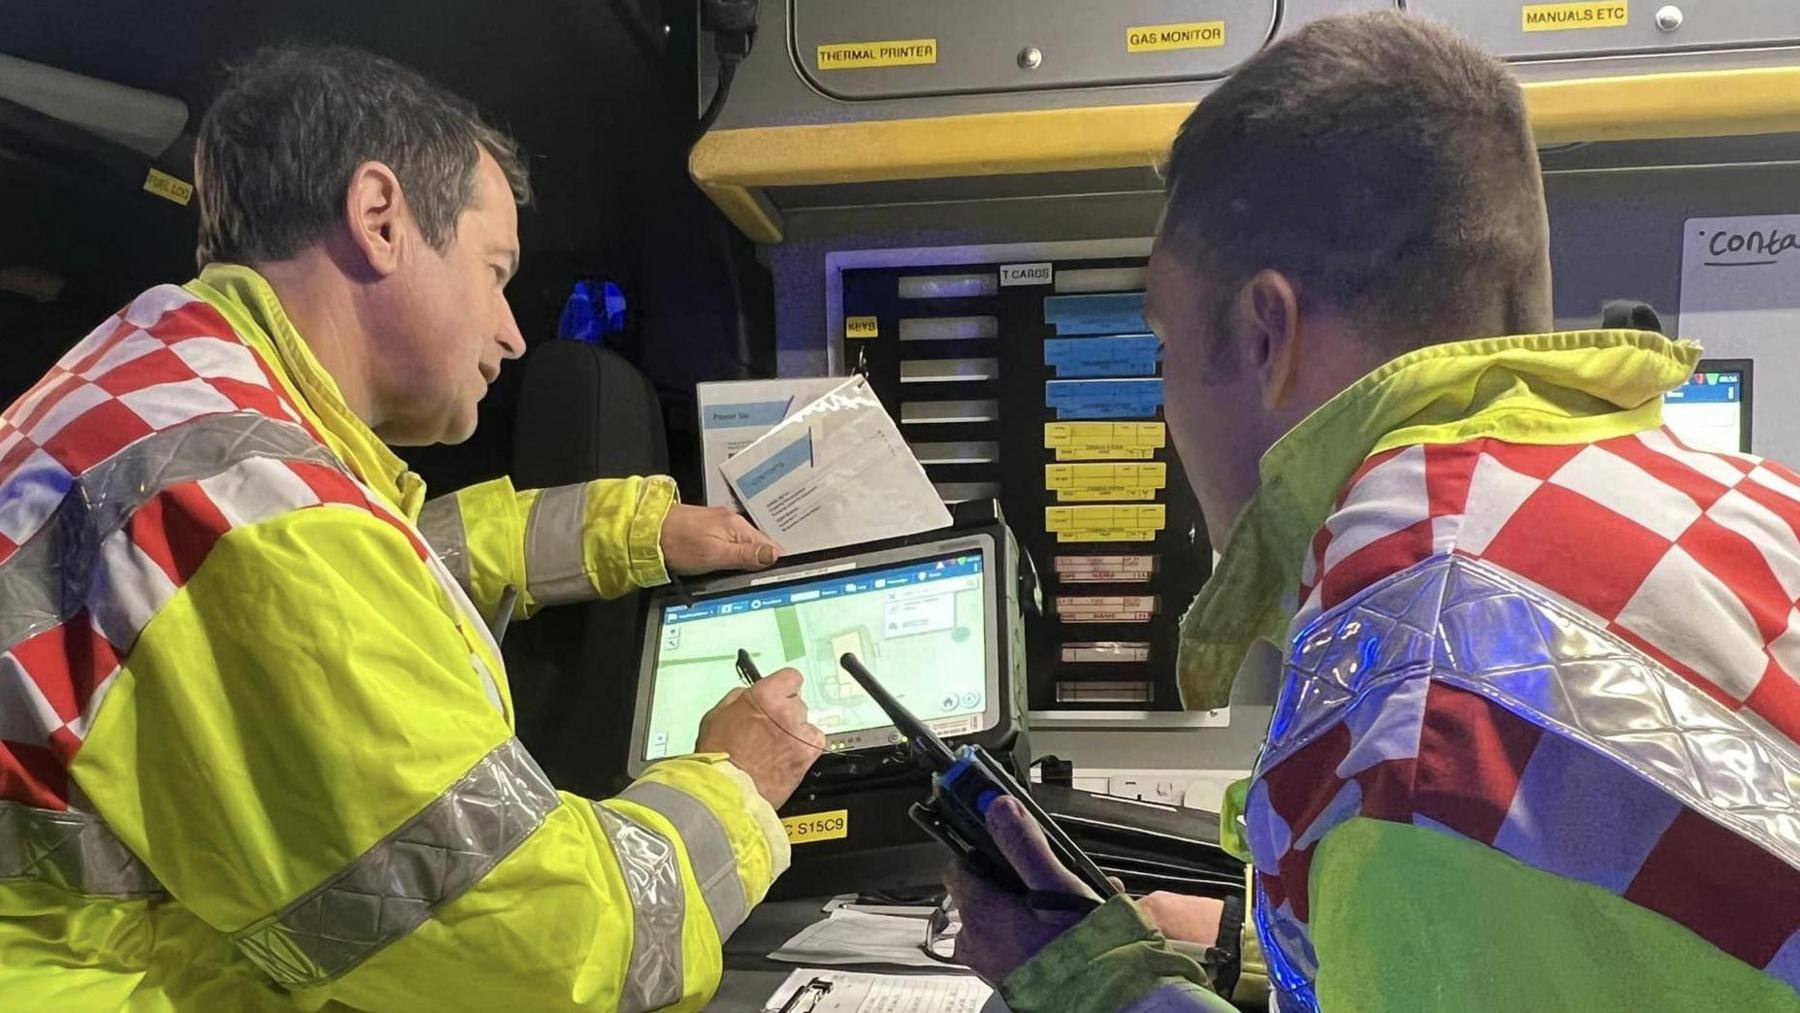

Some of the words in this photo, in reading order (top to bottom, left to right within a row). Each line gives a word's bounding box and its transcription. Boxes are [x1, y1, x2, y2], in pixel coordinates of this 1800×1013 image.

[1526, 9, 1593, 24] MANUALS
[1597, 7, 1624, 20] ETC
[1130, 33, 1157, 46] GAS
[1160, 28, 1221, 42] MONITOR
[820, 49, 876, 62] THERMAL
[880, 45, 933, 59] PRINTER
[1002, 270, 1008, 279] T
[1011, 268, 1050, 279] CARDS
[848, 320, 876, 332] KEYS
[797, 817, 844, 835] S15C9
